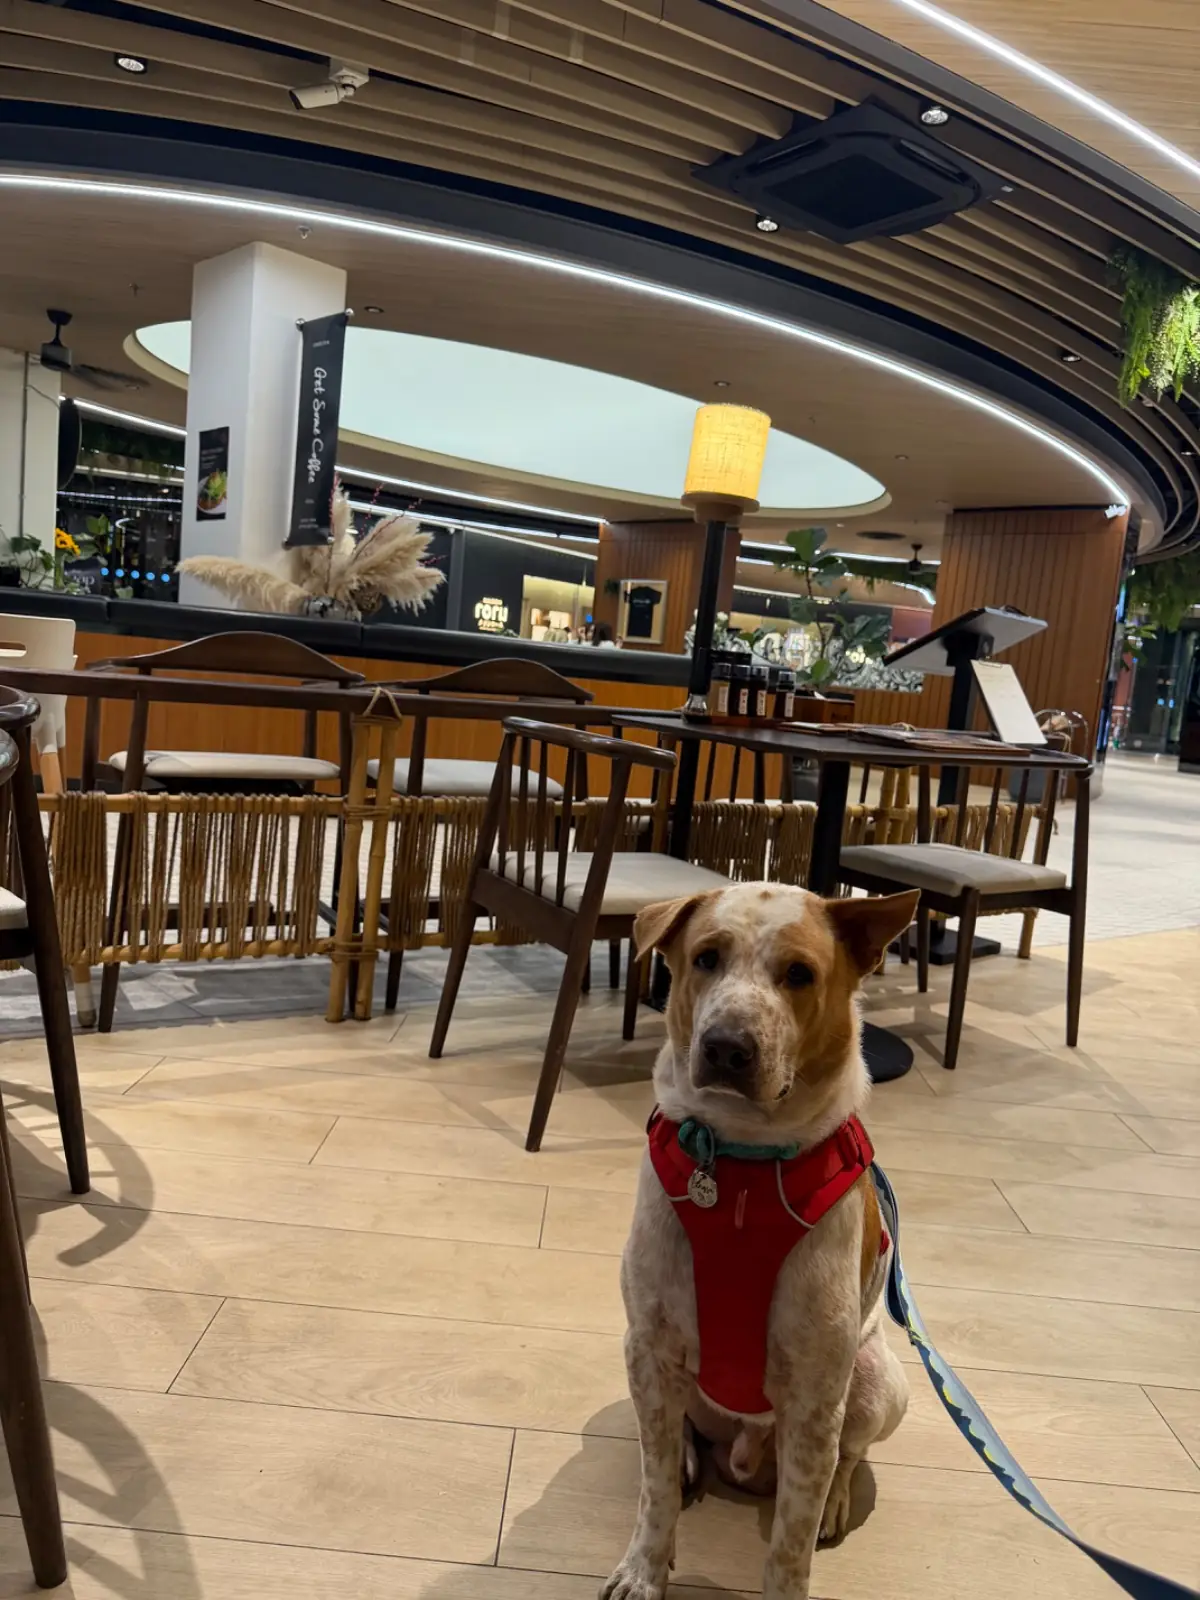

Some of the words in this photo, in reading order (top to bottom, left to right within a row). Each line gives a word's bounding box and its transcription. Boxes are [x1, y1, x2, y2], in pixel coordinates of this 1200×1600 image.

[313, 366, 327, 395] Get
[313, 398, 326, 435] Some
[307, 438, 324, 484] Coffee
